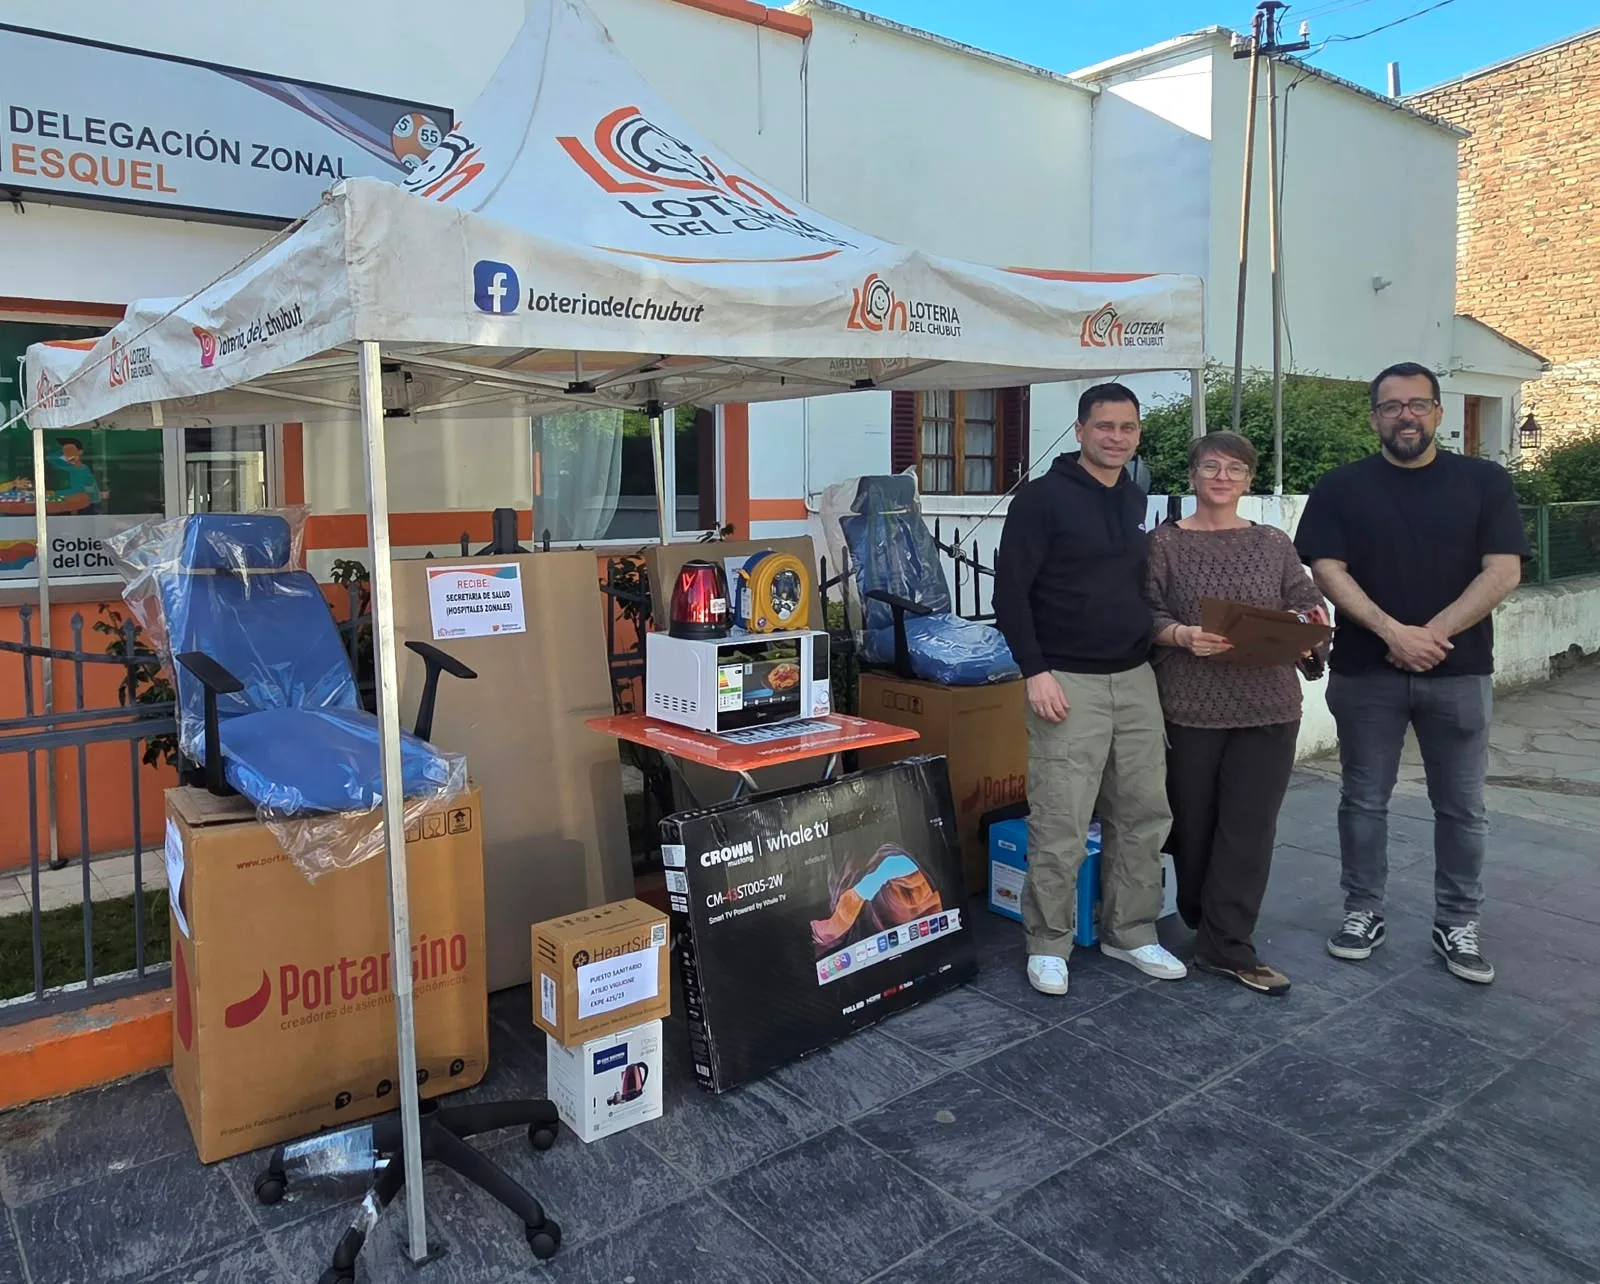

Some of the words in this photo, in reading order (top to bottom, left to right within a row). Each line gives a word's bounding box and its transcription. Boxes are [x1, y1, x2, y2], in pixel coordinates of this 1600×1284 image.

[9, 105, 241, 165] DELEGACIÓN
[250, 143, 352, 180] ZONAL
[420, 129, 438, 143] 55
[12, 143, 177, 193] ESQUEL
[650, 219, 732, 236] DEL
[527, 288, 704, 323] loteriadelchubut
[909, 301, 960, 324] LOTERIA
[909, 321, 925, 333] DEL
[927, 323, 961, 337] CHUBUT
[1124, 321, 1165, 335] LOTERIA
[1124, 336, 1136, 346] DEL
[1136, 336, 1164, 346] CHUBUT
[130, 346, 151, 365] LOTERIA
[52, 537, 104, 552] Gobie
[53, 554, 79, 568] del
[446, 592, 482, 602] SECRETARIA
[483, 592, 490, 600] DE
[492, 590, 511, 599] SALUD
[446, 605, 483, 616] (HOSPITALES
[984, 773, 1026, 805] Porta
[700, 841, 753, 867] CROWN
[709, 914, 725, 925] Smart
[725, 910, 733, 919] TV
[733, 903, 756, 916] Powered
[756, 901, 763, 910] by
[778, 893, 786, 901] TV
[593, 936, 651, 962] HeartSin
[590, 972, 611, 983] PUESTO
[612, 963, 642, 976] SANITARIO
[280, 1008, 338, 1030] creadores
[340, 1001, 353, 1016] de
[355, 995, 396, 1012] asiento
[412, 975, 466, 1000] gonómicos
